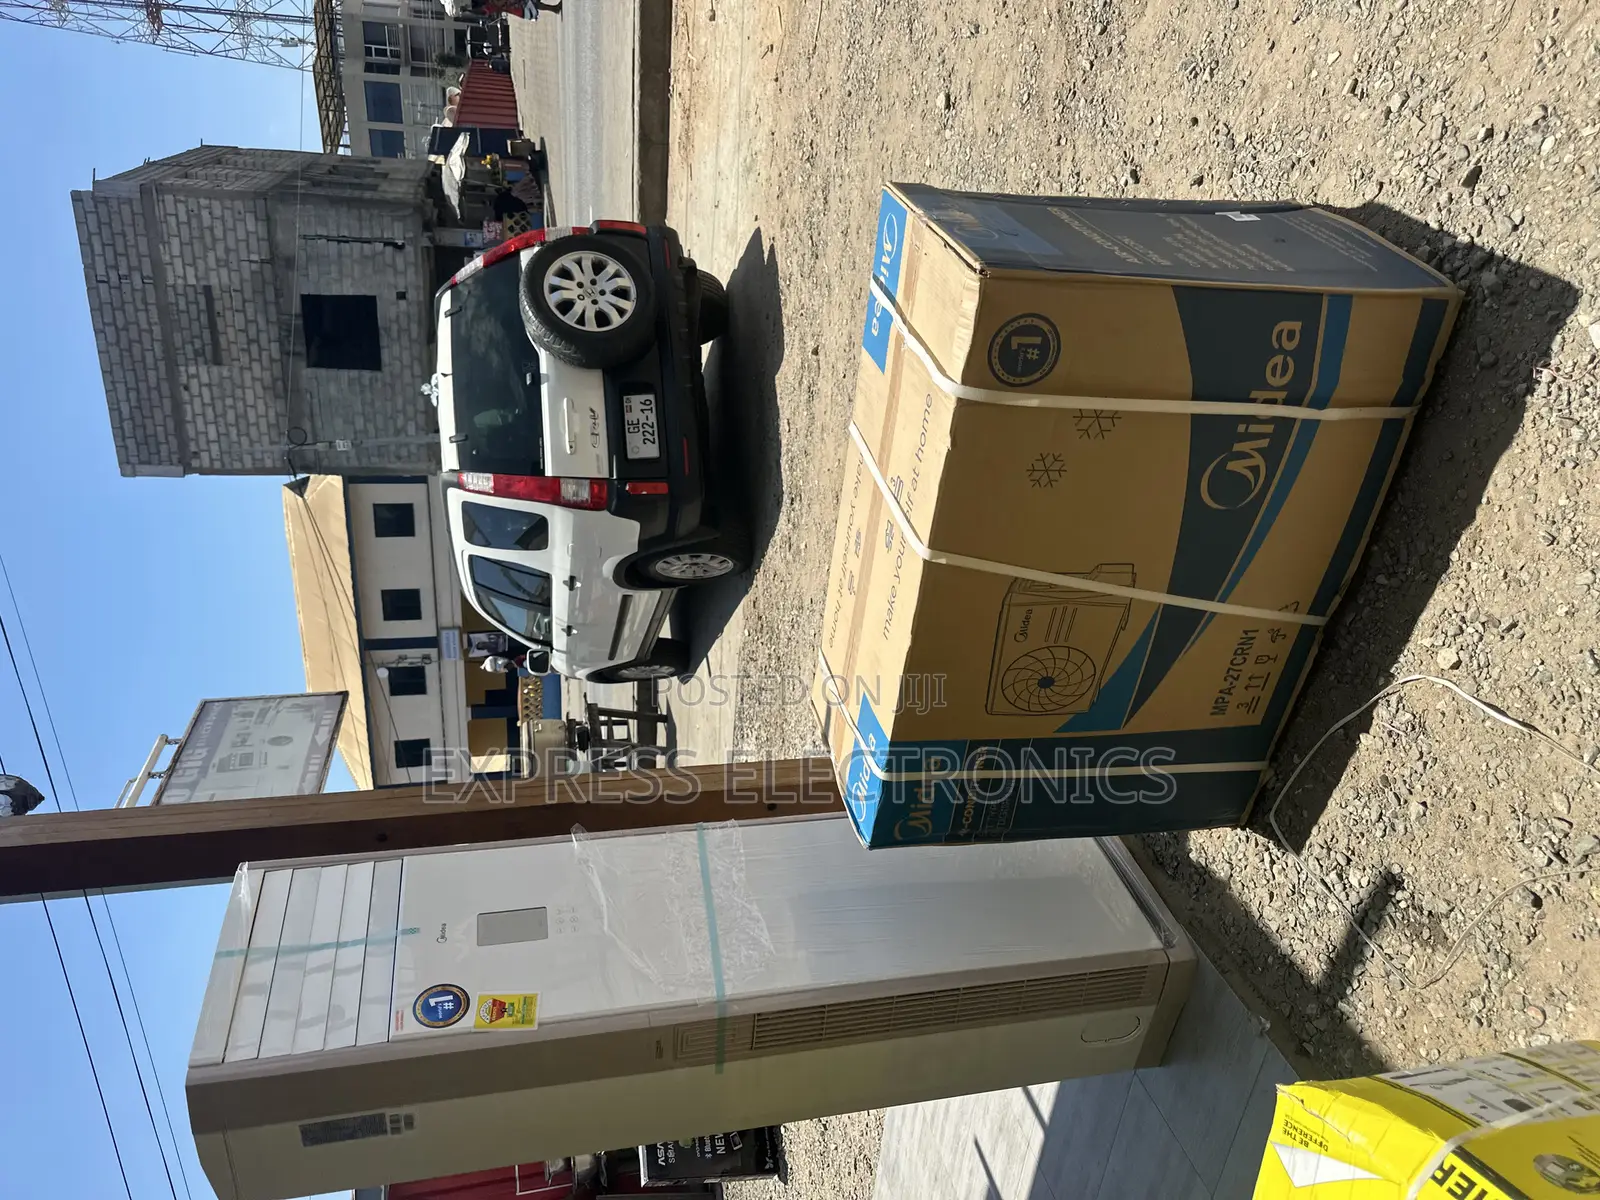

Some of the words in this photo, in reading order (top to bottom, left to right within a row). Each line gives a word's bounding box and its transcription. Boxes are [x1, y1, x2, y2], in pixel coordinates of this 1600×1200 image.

[869, 212, 899, 337] Miea
[1010, 336, 1042, 360] #1
[627, 418, 640, 434] GE
[640, 398, 656, 445] 222-16
[914, 392, 934, 463] home
[908, 465, 921, 491] at
[891, 491, 916, 584] yourelf
[828, 600, 841, 649] home
[881, 585, 898, 640] make
[1013, 609, 1034, 643] Midea
[1209, 628, 1260, 716] MPA-27CRN1
[893, 758, 941, 840] Mida
[436, 923, 447, 943] Midea
[429, 995, 454, 1010] #1
[1282, 1126, 1297, 1141] THE
[1283, 1119, 1329, 1152] DIFFERENCE
[1298, 1137, 1310, 1148] BE
